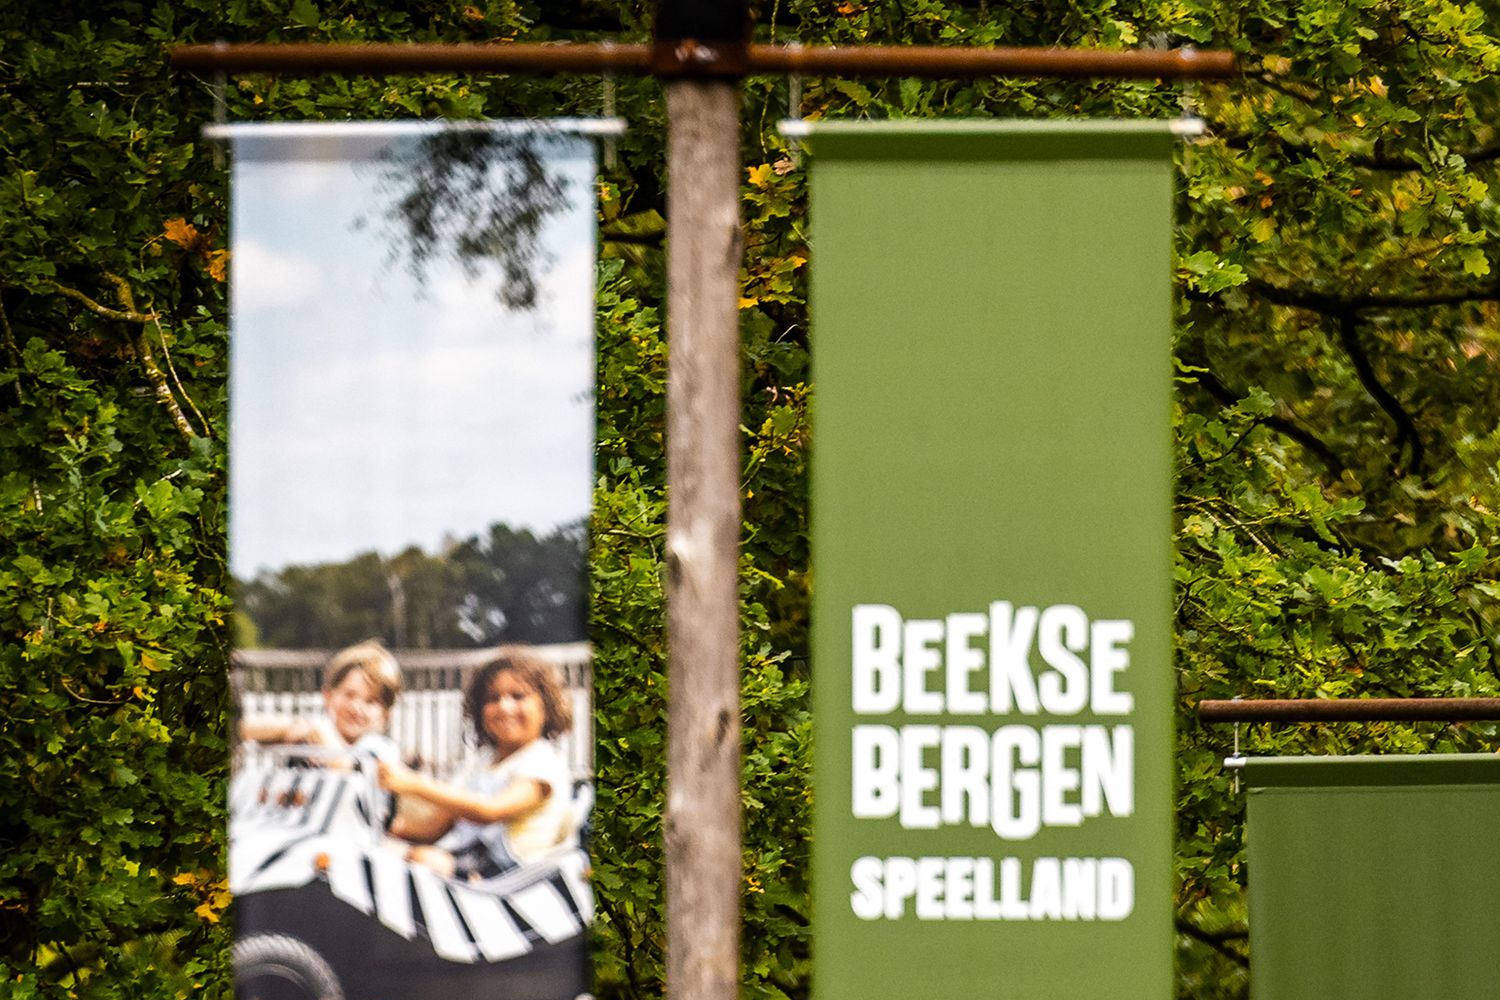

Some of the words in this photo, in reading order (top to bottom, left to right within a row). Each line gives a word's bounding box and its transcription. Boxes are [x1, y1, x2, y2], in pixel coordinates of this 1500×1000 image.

[852, 601, 1134, 714] BEEKSE
[852, 725, 1134, 839] BERGEN
[851, 856, 1134, 920] SPEELLAND
